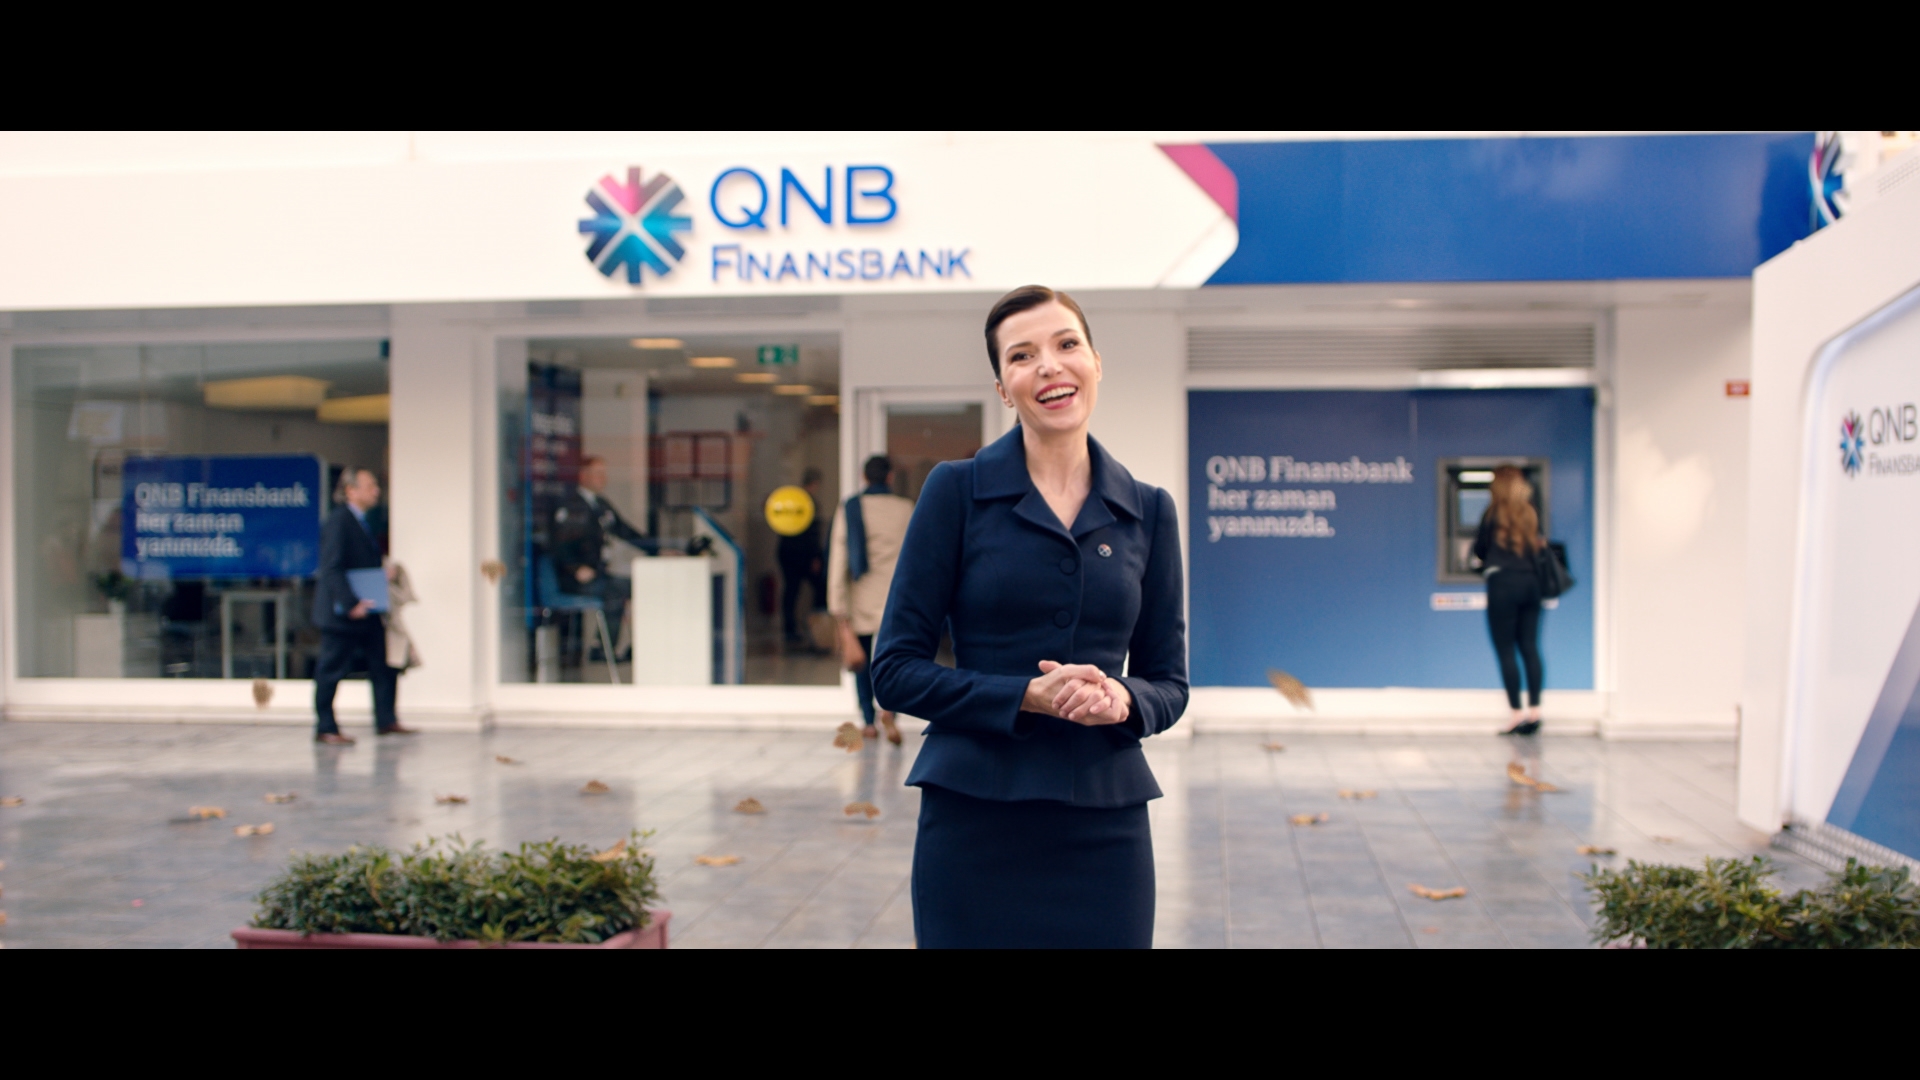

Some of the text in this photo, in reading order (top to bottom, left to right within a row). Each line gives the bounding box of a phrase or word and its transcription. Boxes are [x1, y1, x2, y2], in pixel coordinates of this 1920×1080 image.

[710, 165, 898, 228] QNB
[711, 245, 970, 280] FINANSBANK
[1869, 404, 1918, 445] QNB
[1206, 456, 1414, 485] QNB Finansbank
[134, 482, 308, 510] QNB Finansbank
[1208, 486, 1336, 510] her zaman
[135, 512, 243, 532] her zaman
[1207, 512, 1335, 541] yanınızda.
[135, 534, 242, 559] yanınızda.
